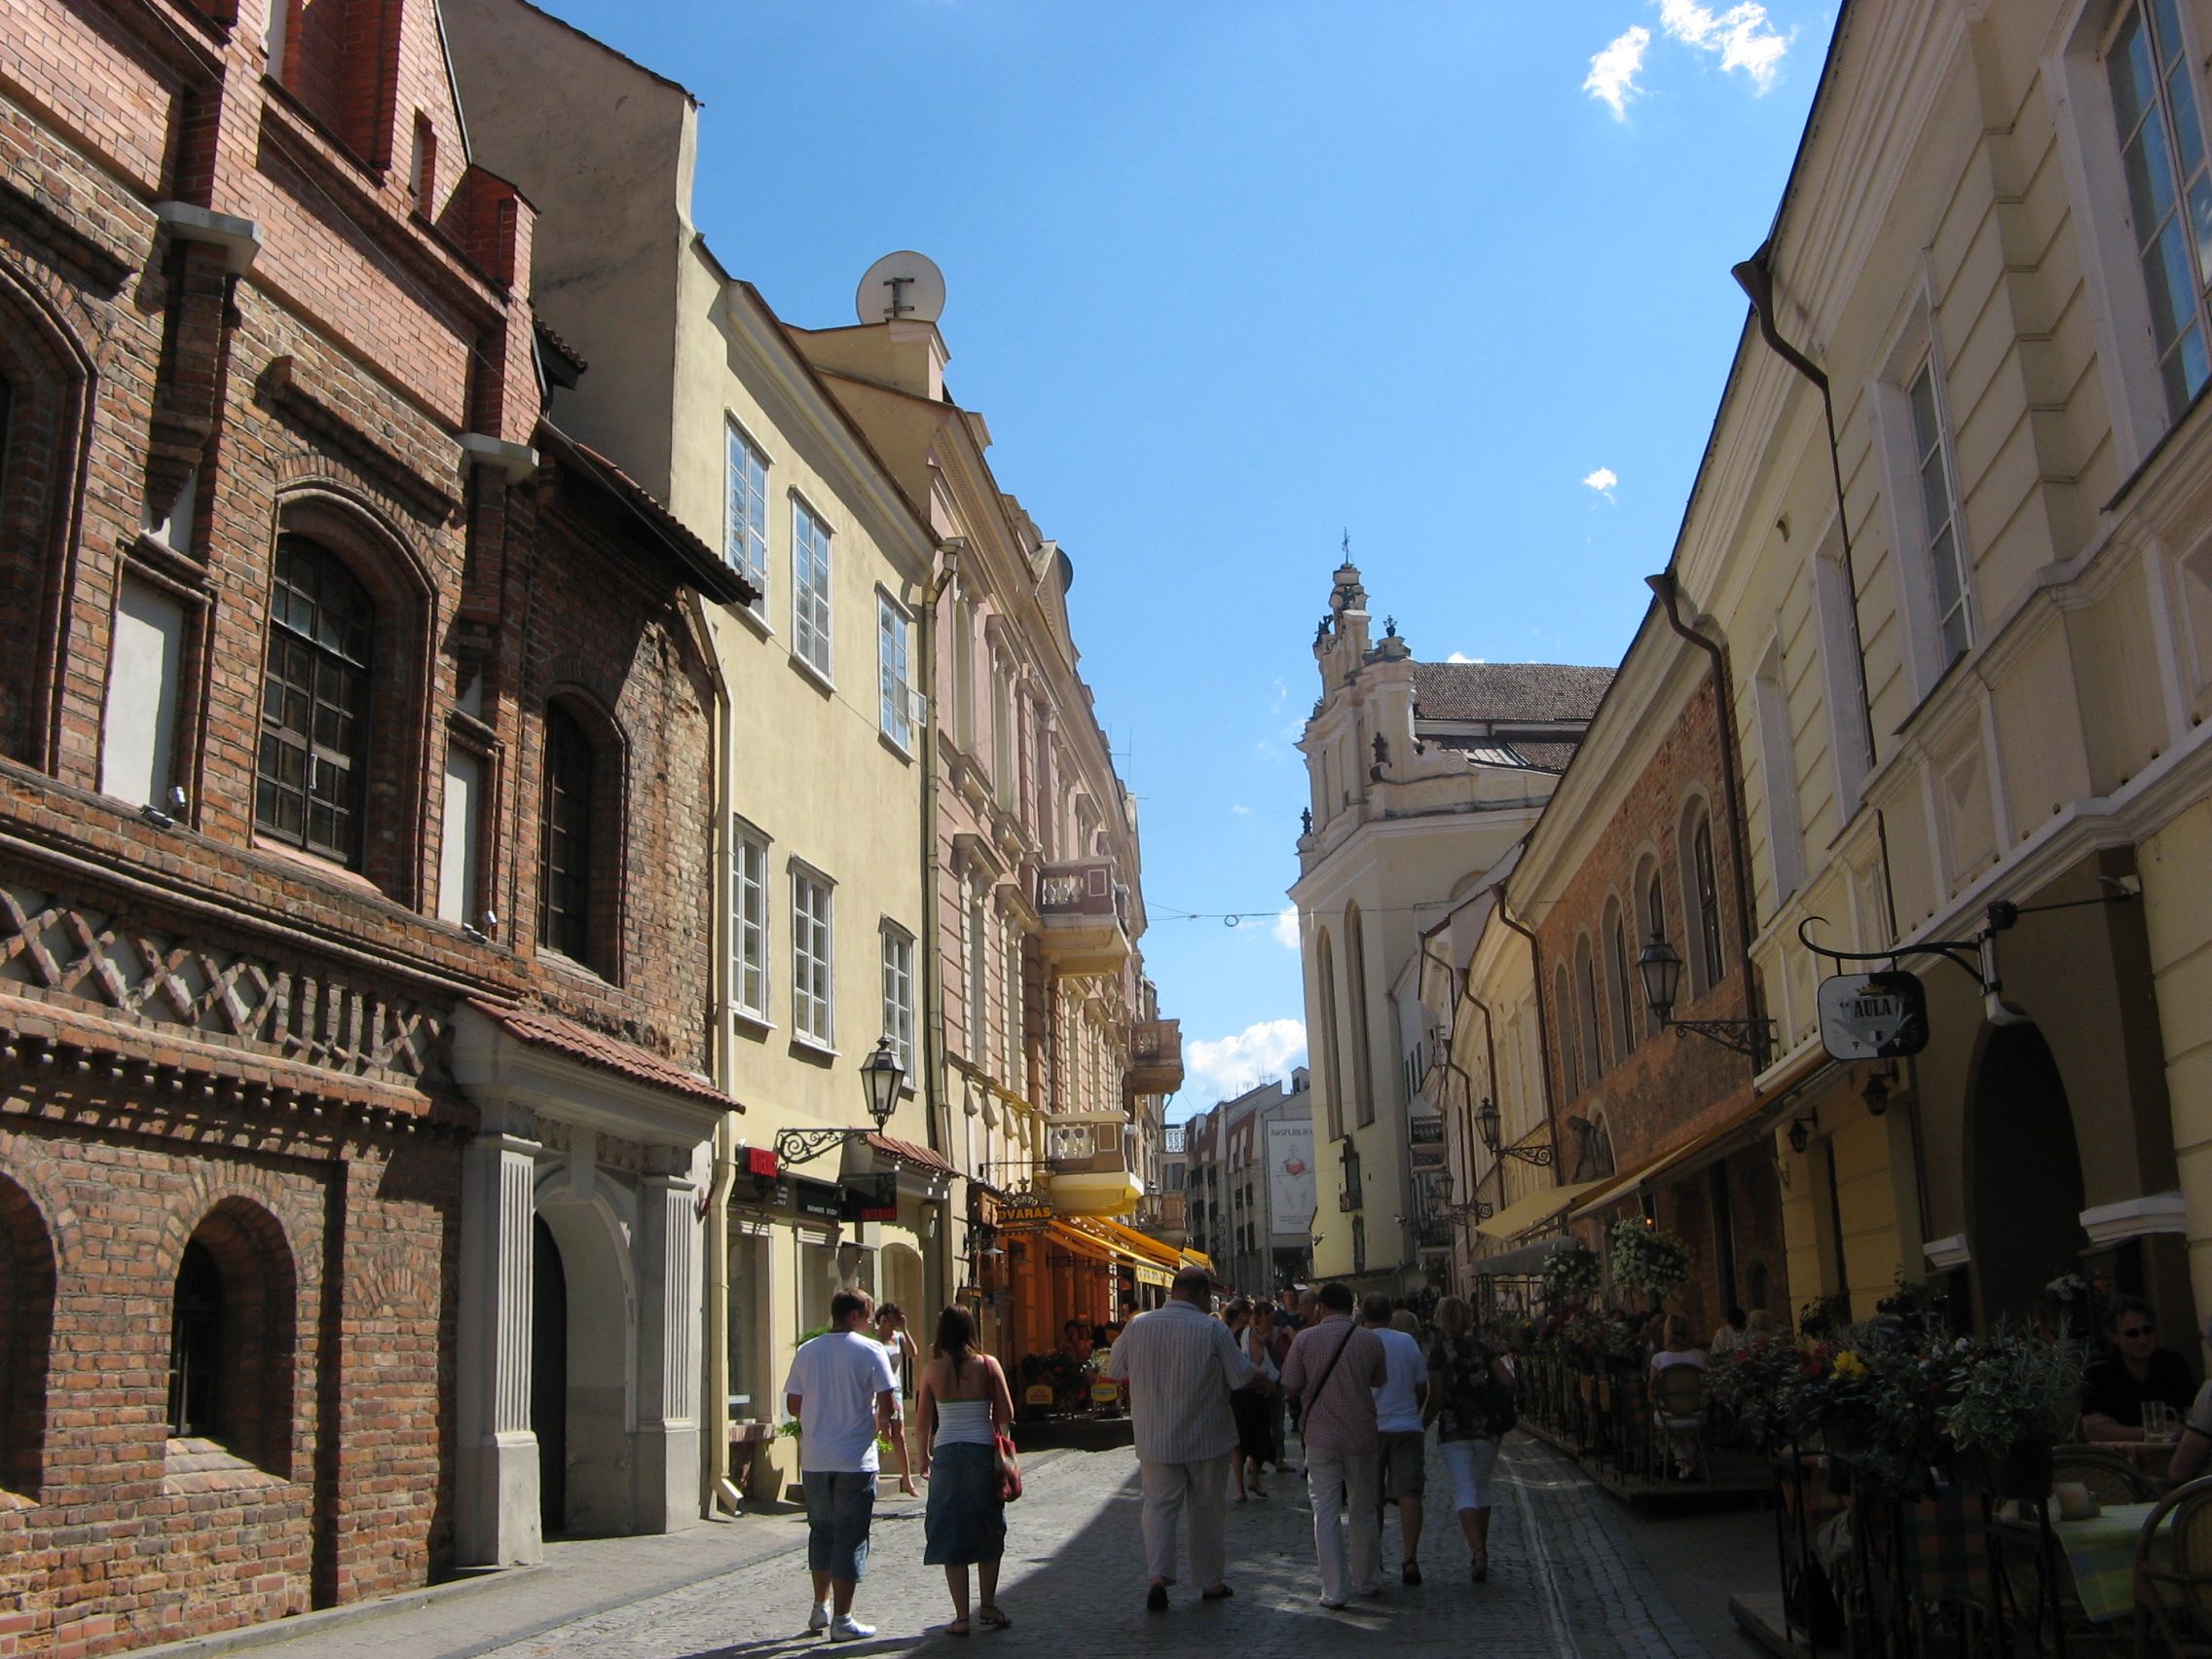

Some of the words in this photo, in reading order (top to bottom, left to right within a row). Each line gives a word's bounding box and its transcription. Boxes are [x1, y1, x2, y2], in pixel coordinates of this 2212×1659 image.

[1854, 999, 1893, 1018] AULA
[1011, 1196, 1039, 1207] PORTO
[998, 1206, 1051, 1220] DVARAS
